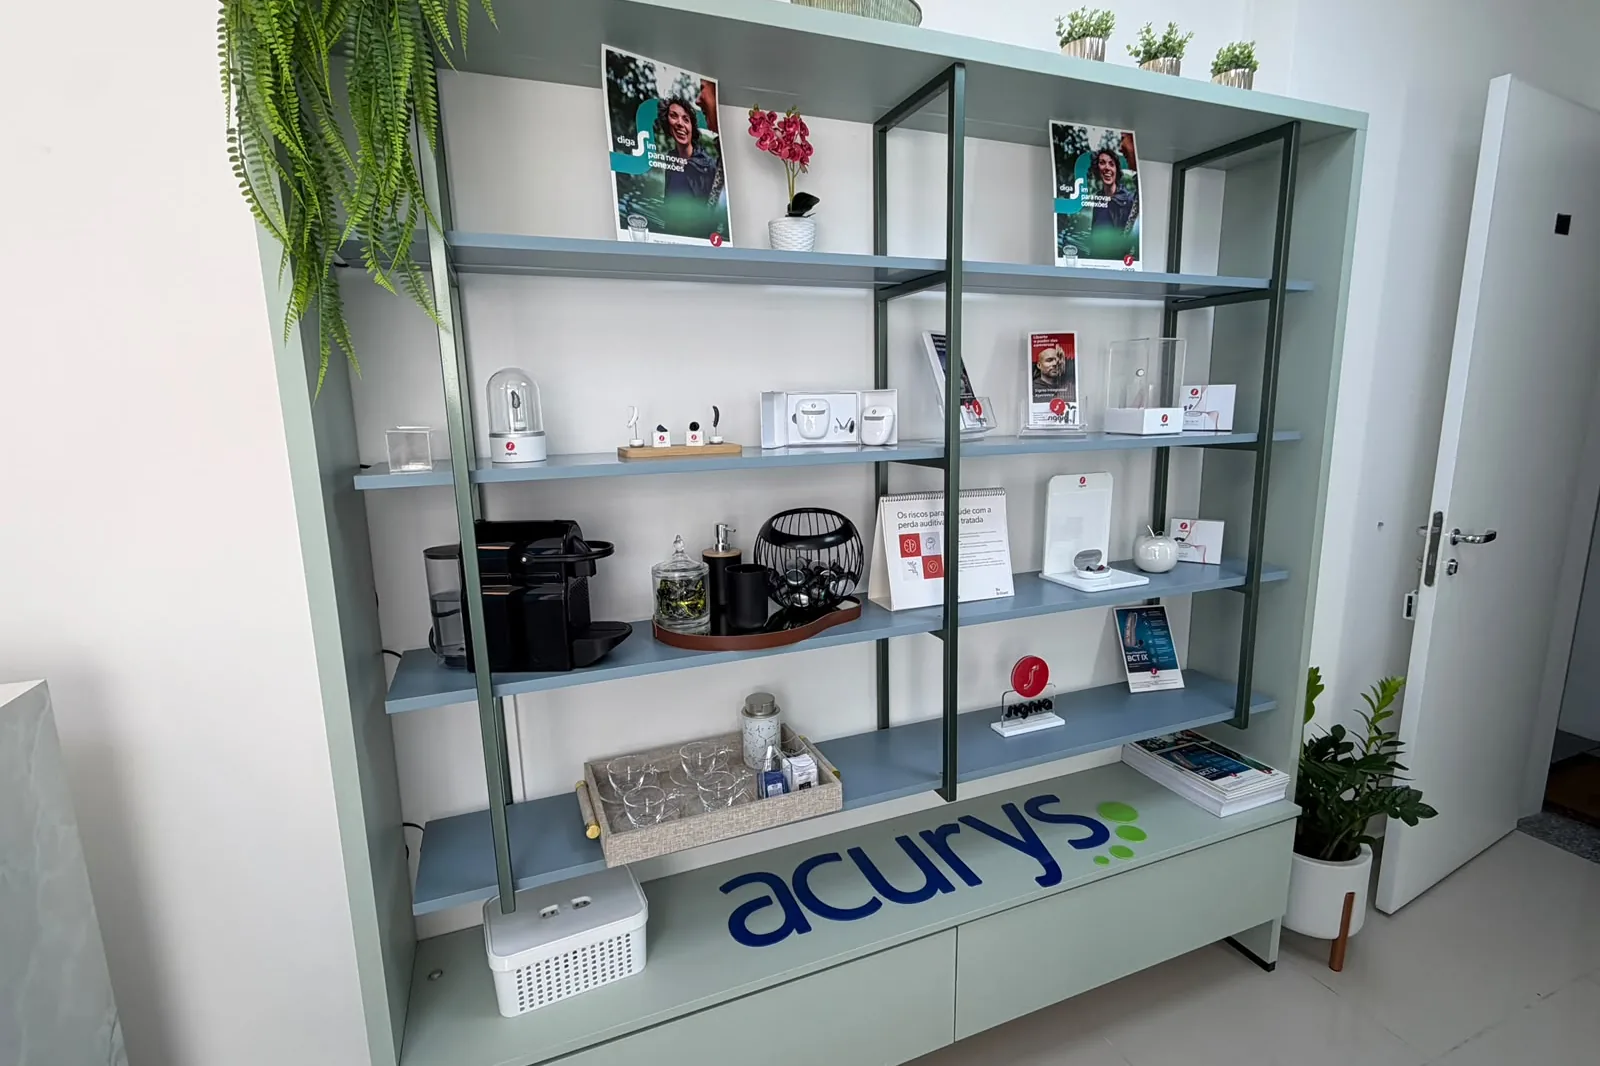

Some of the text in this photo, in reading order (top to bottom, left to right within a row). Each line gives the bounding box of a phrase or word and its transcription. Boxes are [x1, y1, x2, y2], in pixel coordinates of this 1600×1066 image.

[617, 136, 636, 147] diga
[648, 151, 688, 165] para novas
[648, 160, 685, 173] conexões
[1059, 184, 1073, 193] diga
[897, 511, 907, 519] Os
[908, 510, 928, 518] riscos
[898, 520, 918, 530] perda
[961, 516, 983, 524] tratada
[719, 794, 1110, 947] acurys
